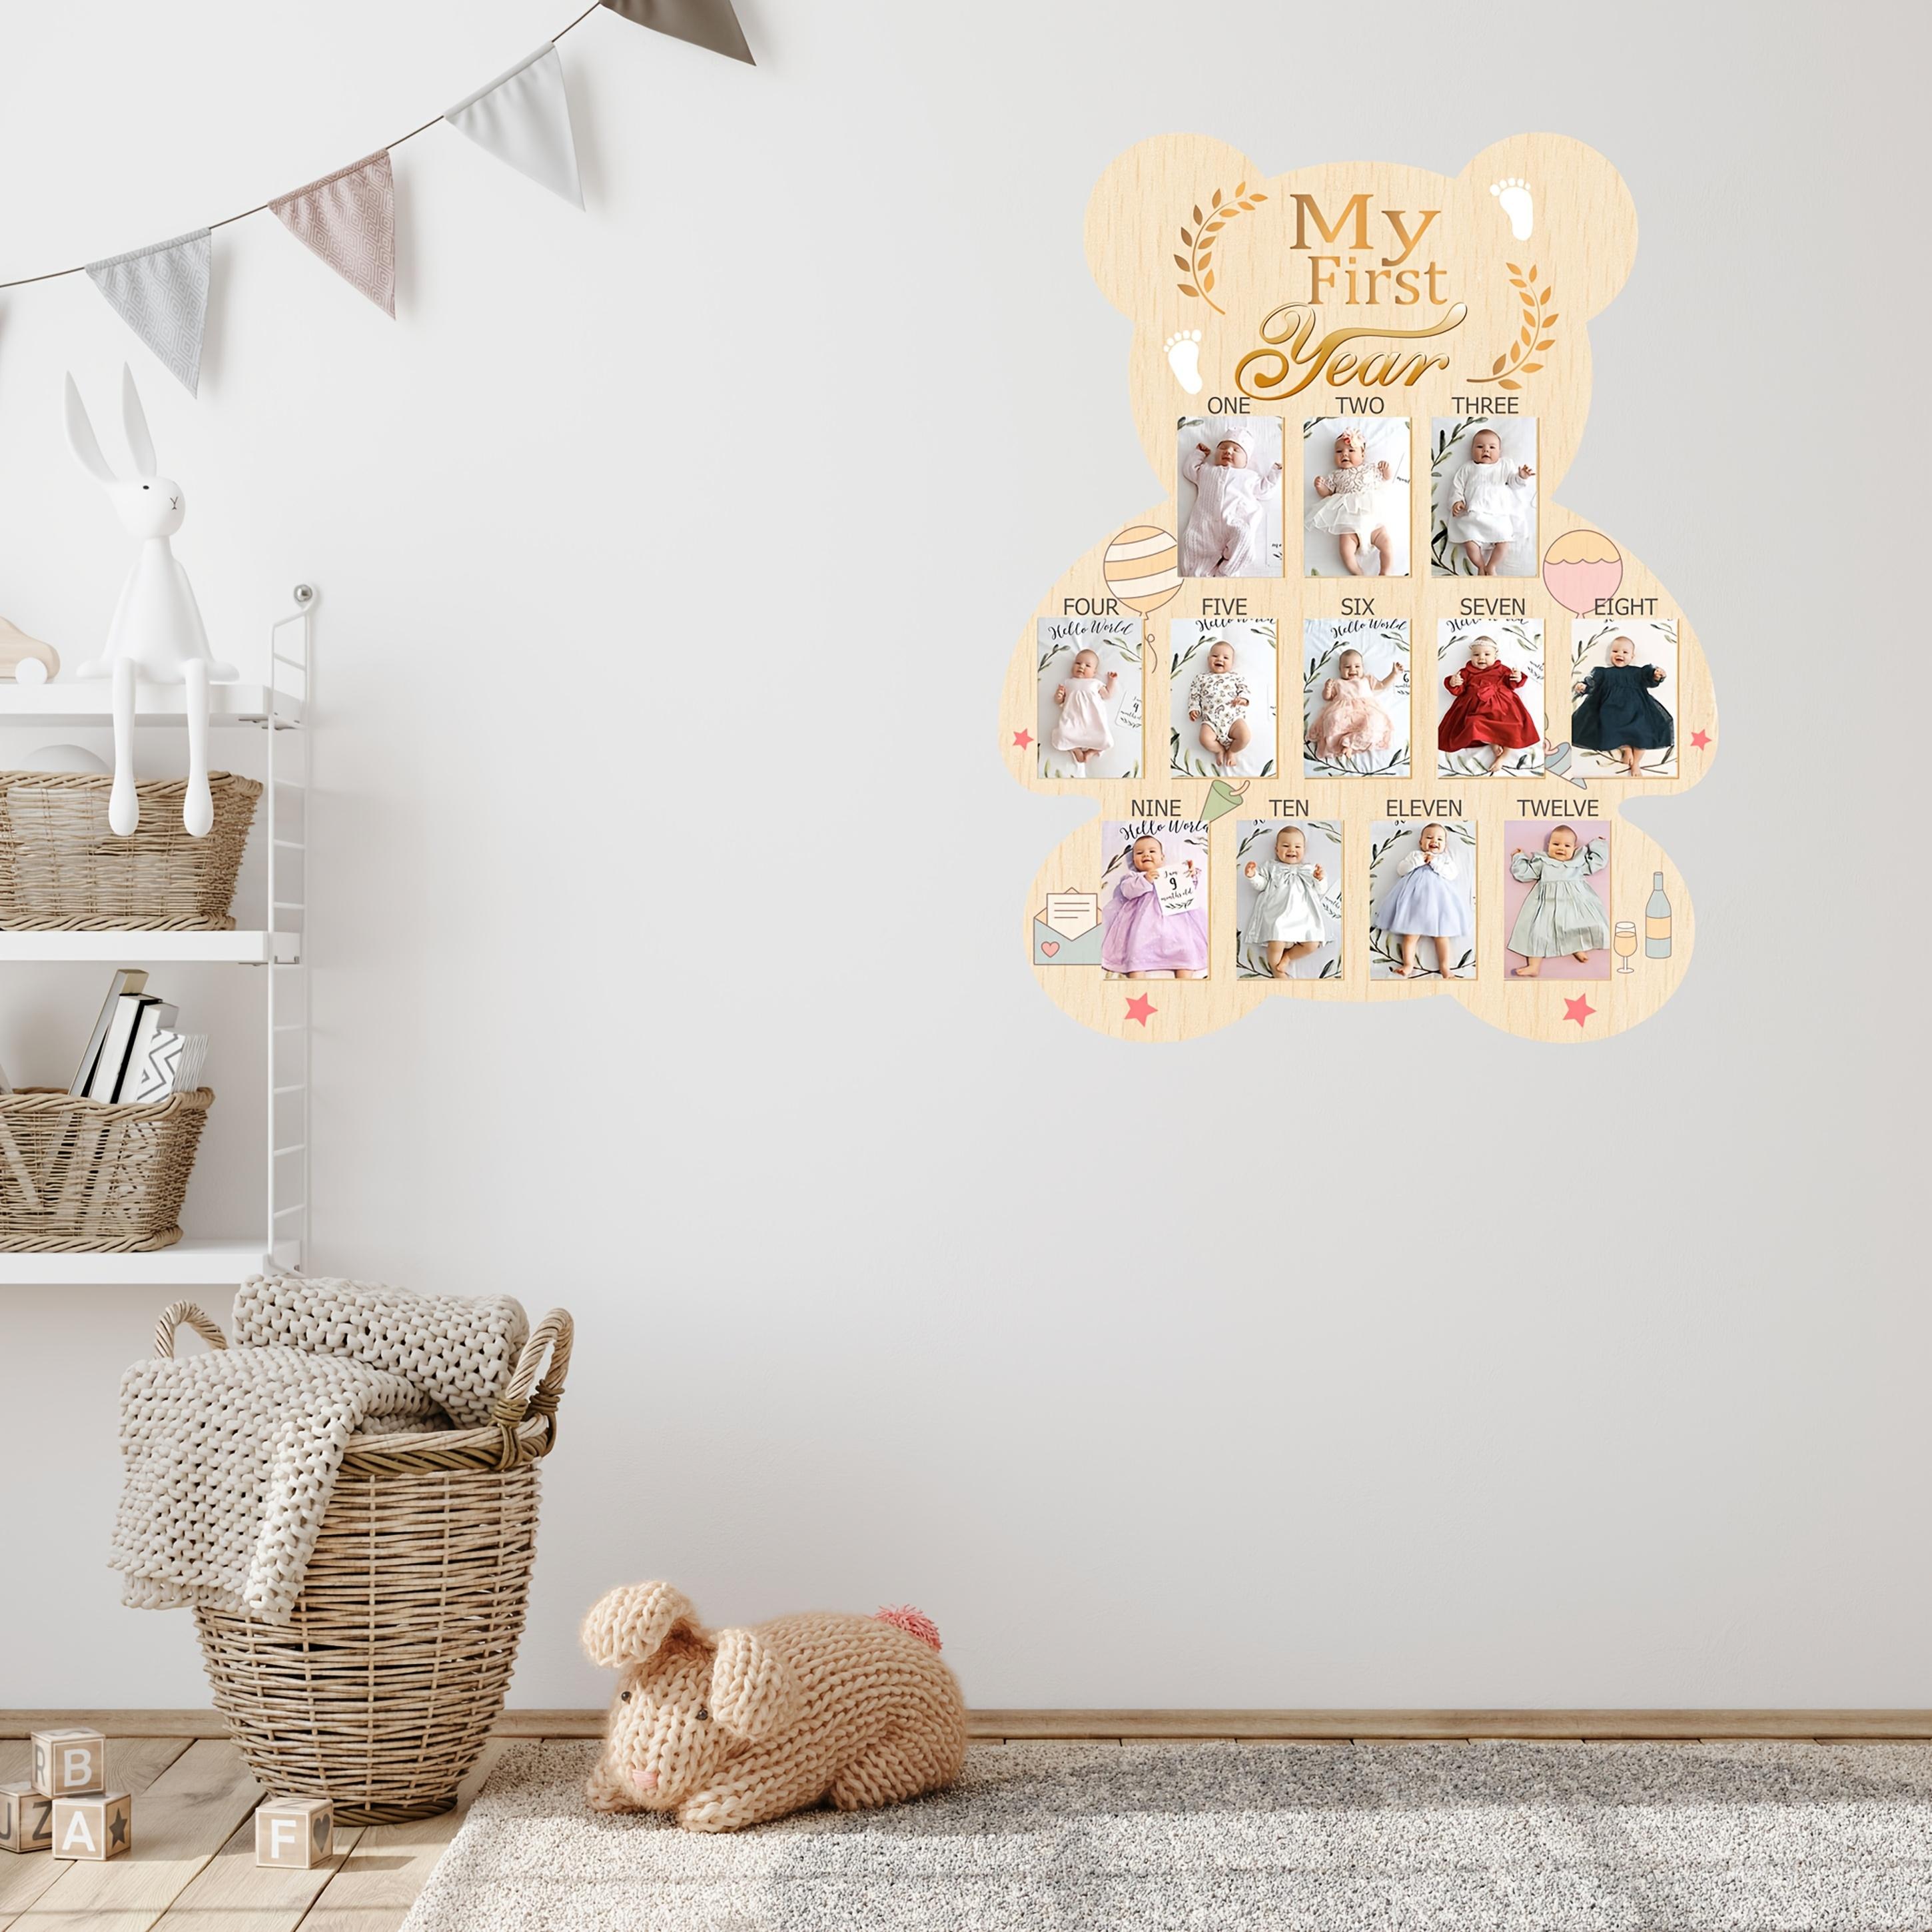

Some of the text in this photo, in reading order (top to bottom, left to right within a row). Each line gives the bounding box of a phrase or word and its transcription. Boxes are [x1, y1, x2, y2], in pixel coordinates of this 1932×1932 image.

[1290, 194, 1441, 266] My
[1308, 256, 1448, 305] First
[1234, 302, 1468, 400] Year
[1207, 397, 1250, 414] ONE
[1335, 397, 1384, 414] TWO
[1451, 397, 1519, 414] THREE
[1064, 598, 1119, 616] FOUR
[1203, 598, 1247, 616] FIVE
[1341, 598, 1374, 616] SIX
[1460, 598, 1525, 616] SEVEN
[1595, 598, 1658, 616] EIGHT
[1048, 618, 1133, 640] Hello World
[1330, 618, 1407, 639] Hello World
[1403, 673, 1410, 683] 6
[1132, 799, 1181, 817] NINE
[1268, 799, 1308, 817] TEN
[1387, 799, 1462, 817] ELEVEN
[1517, 799, 1599, 817] TWELVE
[1120, 820, 1166, 841] Hello
[1169, 877, 1177, 891] 9
[35, 1744, 46, 1787] R
[63, 1748, 93, 1787] B
[33, 1800, 52, 1841] Z
[61, 1810, 97, 1853] A
[271, 1819, 296, 1859] F
